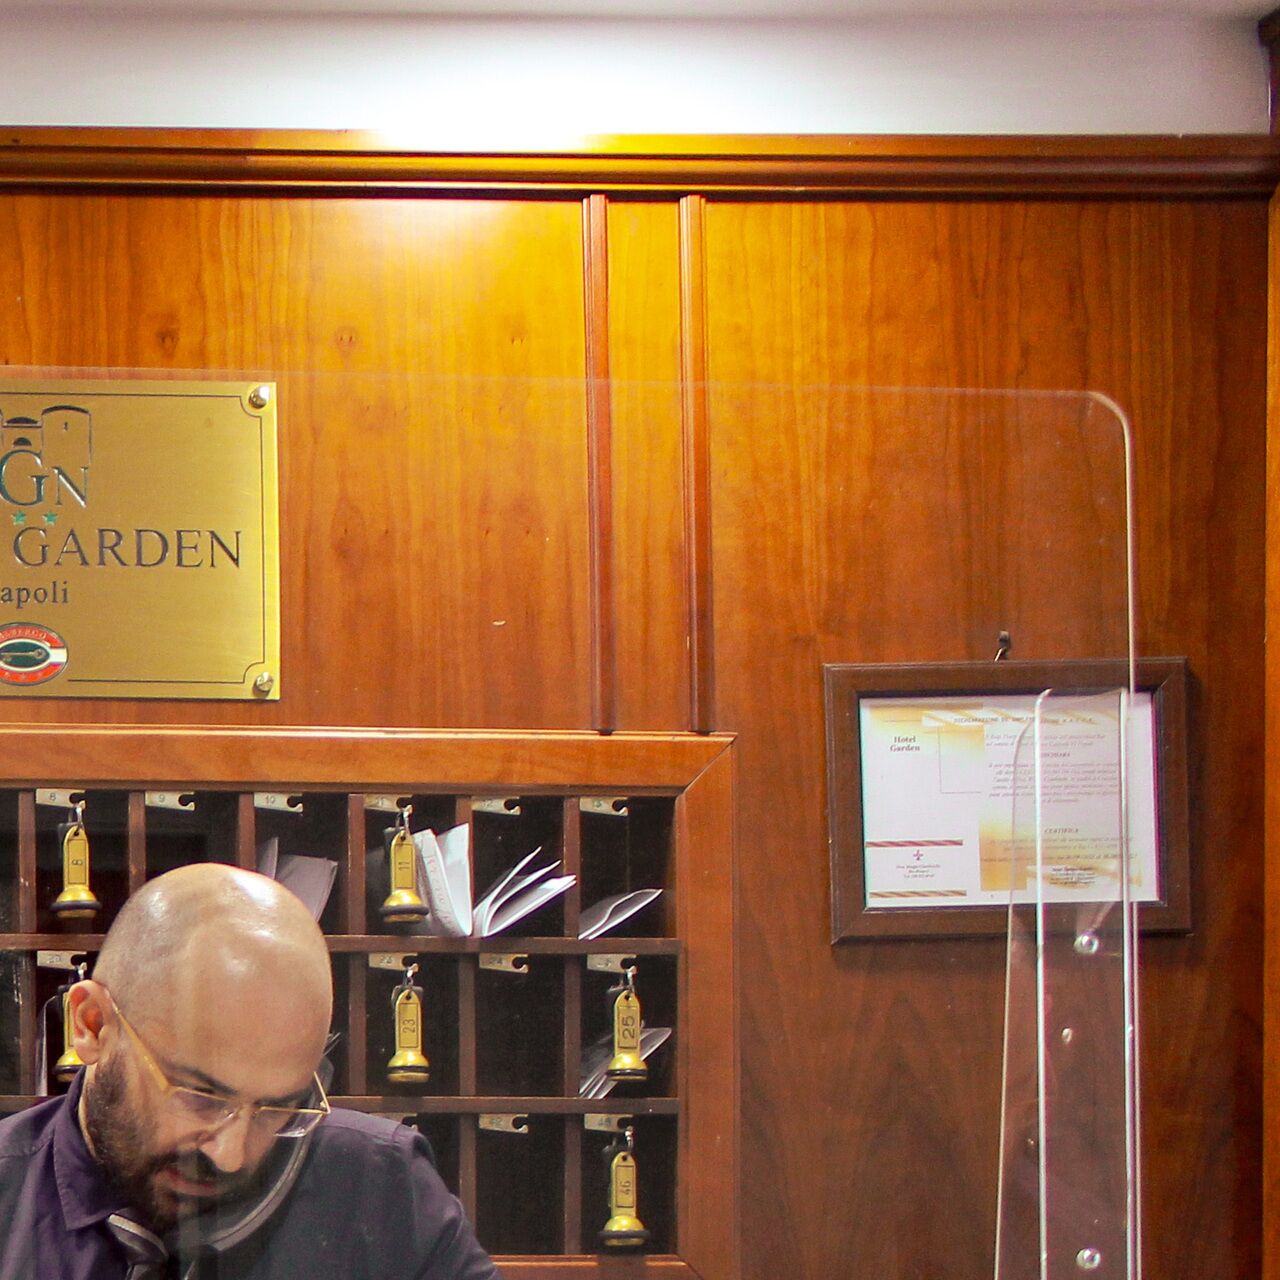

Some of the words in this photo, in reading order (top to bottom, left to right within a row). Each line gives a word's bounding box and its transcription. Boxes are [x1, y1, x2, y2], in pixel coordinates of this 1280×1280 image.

[14, 526, 241, 568] GARDEN
[890, 744, 920, 752] Garden
[402, 1018, 416, 1034] 23
[621, 1015, 636, 1040] 25
